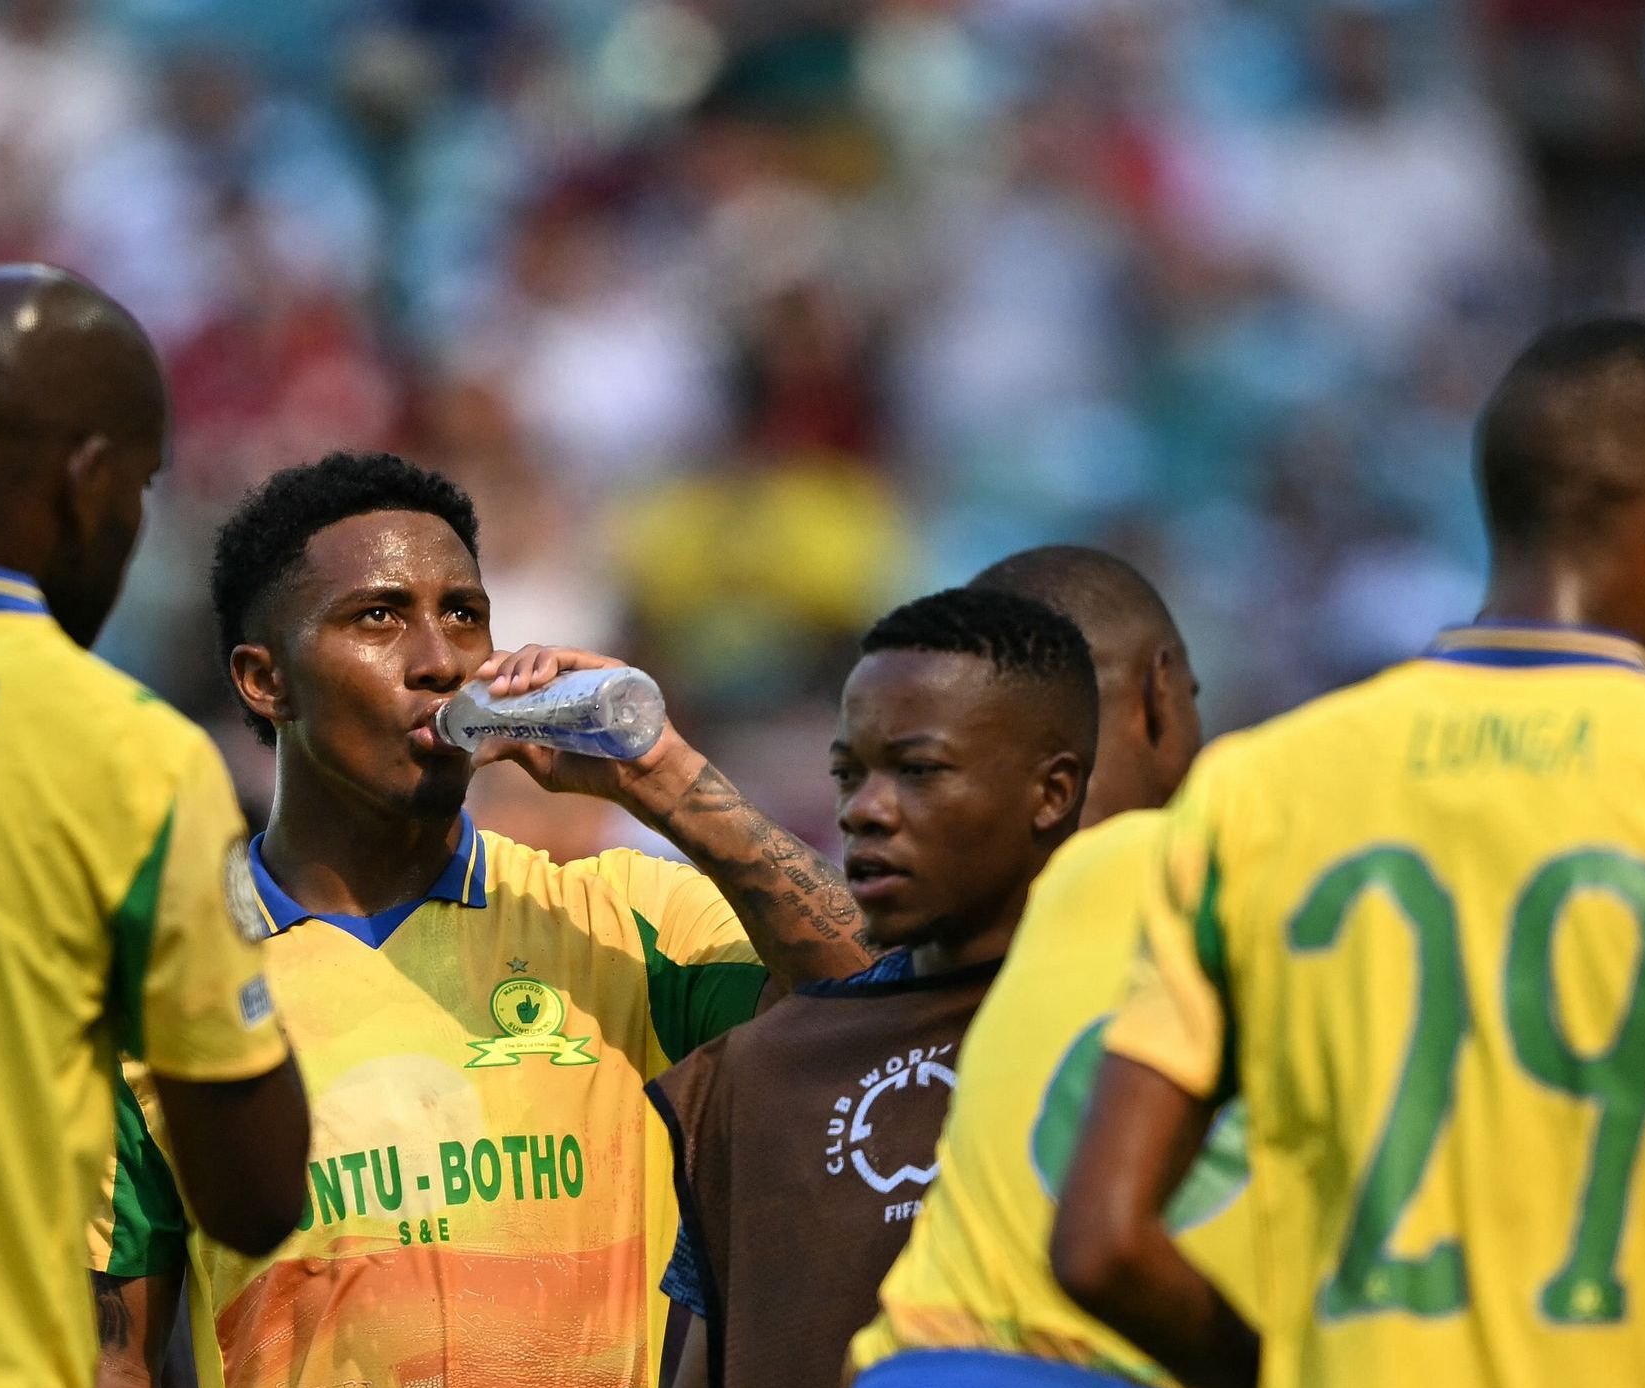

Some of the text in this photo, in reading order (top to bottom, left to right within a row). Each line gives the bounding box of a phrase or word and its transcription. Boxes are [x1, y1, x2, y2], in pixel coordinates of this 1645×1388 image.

[1407, 708, 1594, 779] LUNGA
[438, 1134, 584, 1206] BOTHO
[825, 1096, 853, 1176] CLUB
[398, 1217, 450, 1246] S & E
